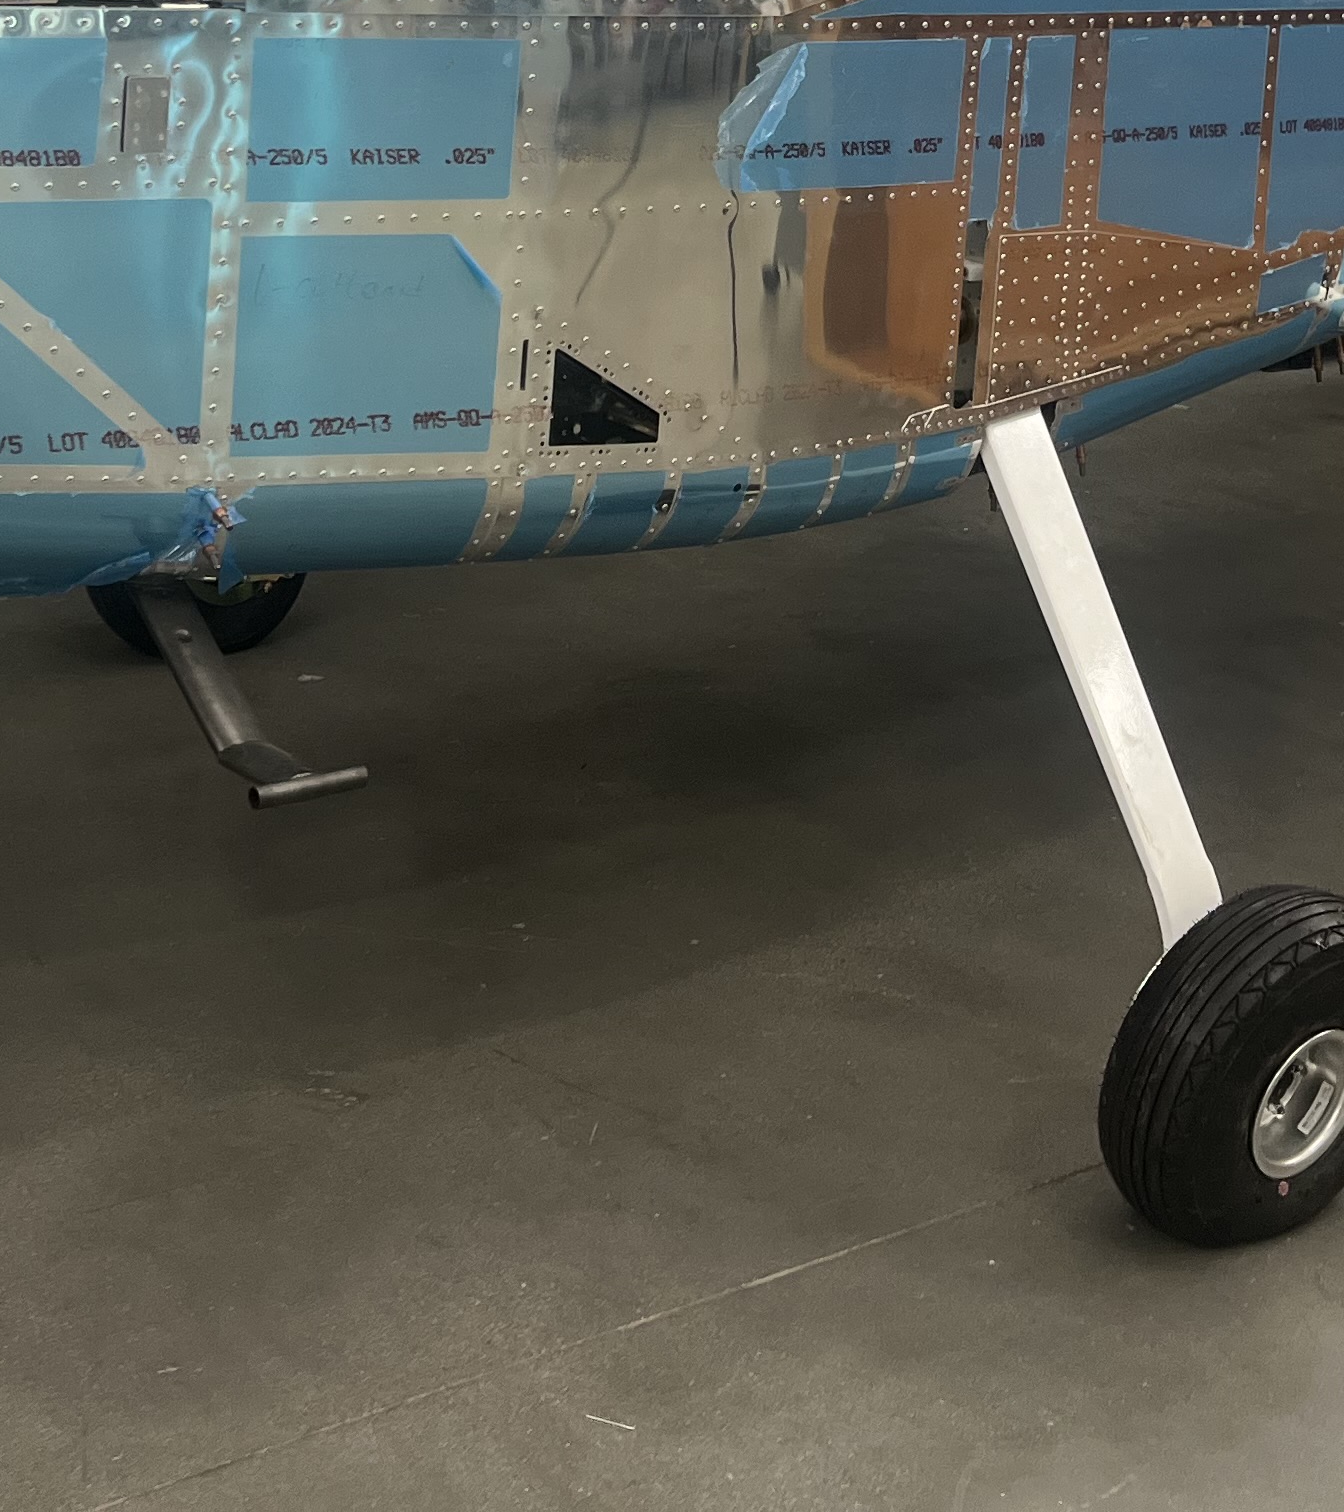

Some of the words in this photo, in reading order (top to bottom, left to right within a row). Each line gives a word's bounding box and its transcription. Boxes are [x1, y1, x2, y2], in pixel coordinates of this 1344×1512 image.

[1189, 124, 1227, 139] KAISER
[1279, 119, 1297, 134] LOT
[349, 148, 420, 165] KAISER
[444, 147, 495, 165] .025"
[841, 138, 892, 157] KAISER
[47, 432, 89, 452] LOT
[309, 414, 391, 438] 2024-T3
